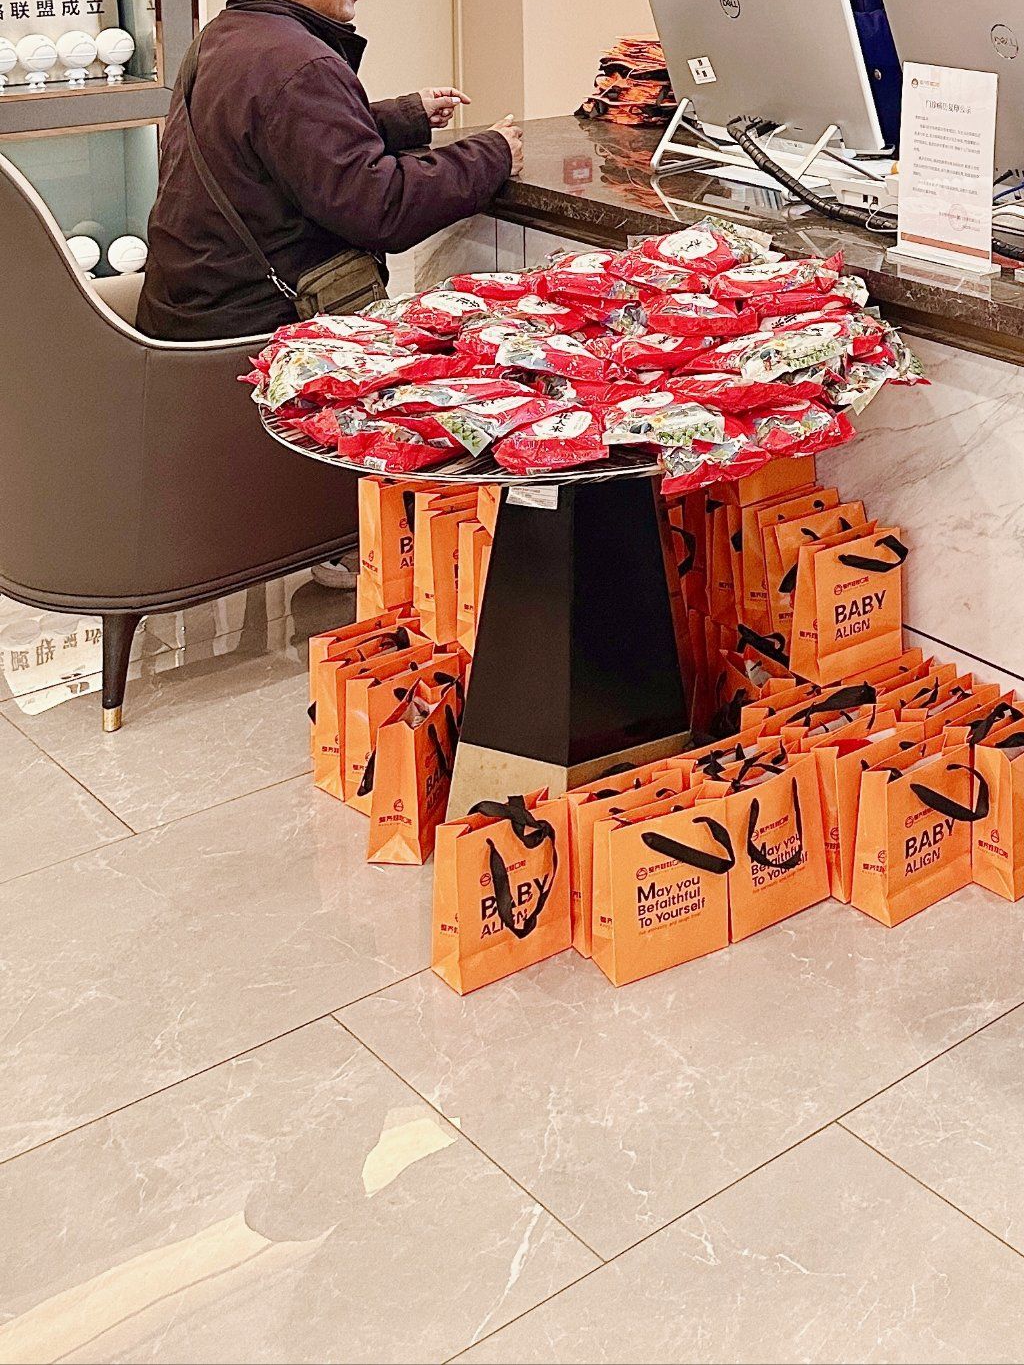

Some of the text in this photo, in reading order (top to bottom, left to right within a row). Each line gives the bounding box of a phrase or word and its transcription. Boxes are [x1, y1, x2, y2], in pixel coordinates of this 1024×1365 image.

[834, 589, 887, 625] BABY
[834, 617, 871, 642] ALIGN
[905, 818, 956, 860] BABY
[905, 846, 941, 877] ALIGN
[481, 873, 550, 921] BBY
[637, 875, 701, 904] May you
[752, 876, 765, 887] To
[637, 886, 701, 917] Befaithful
[638, 917, 653, 929] To
[655, 896, 706, 924] Yourself
